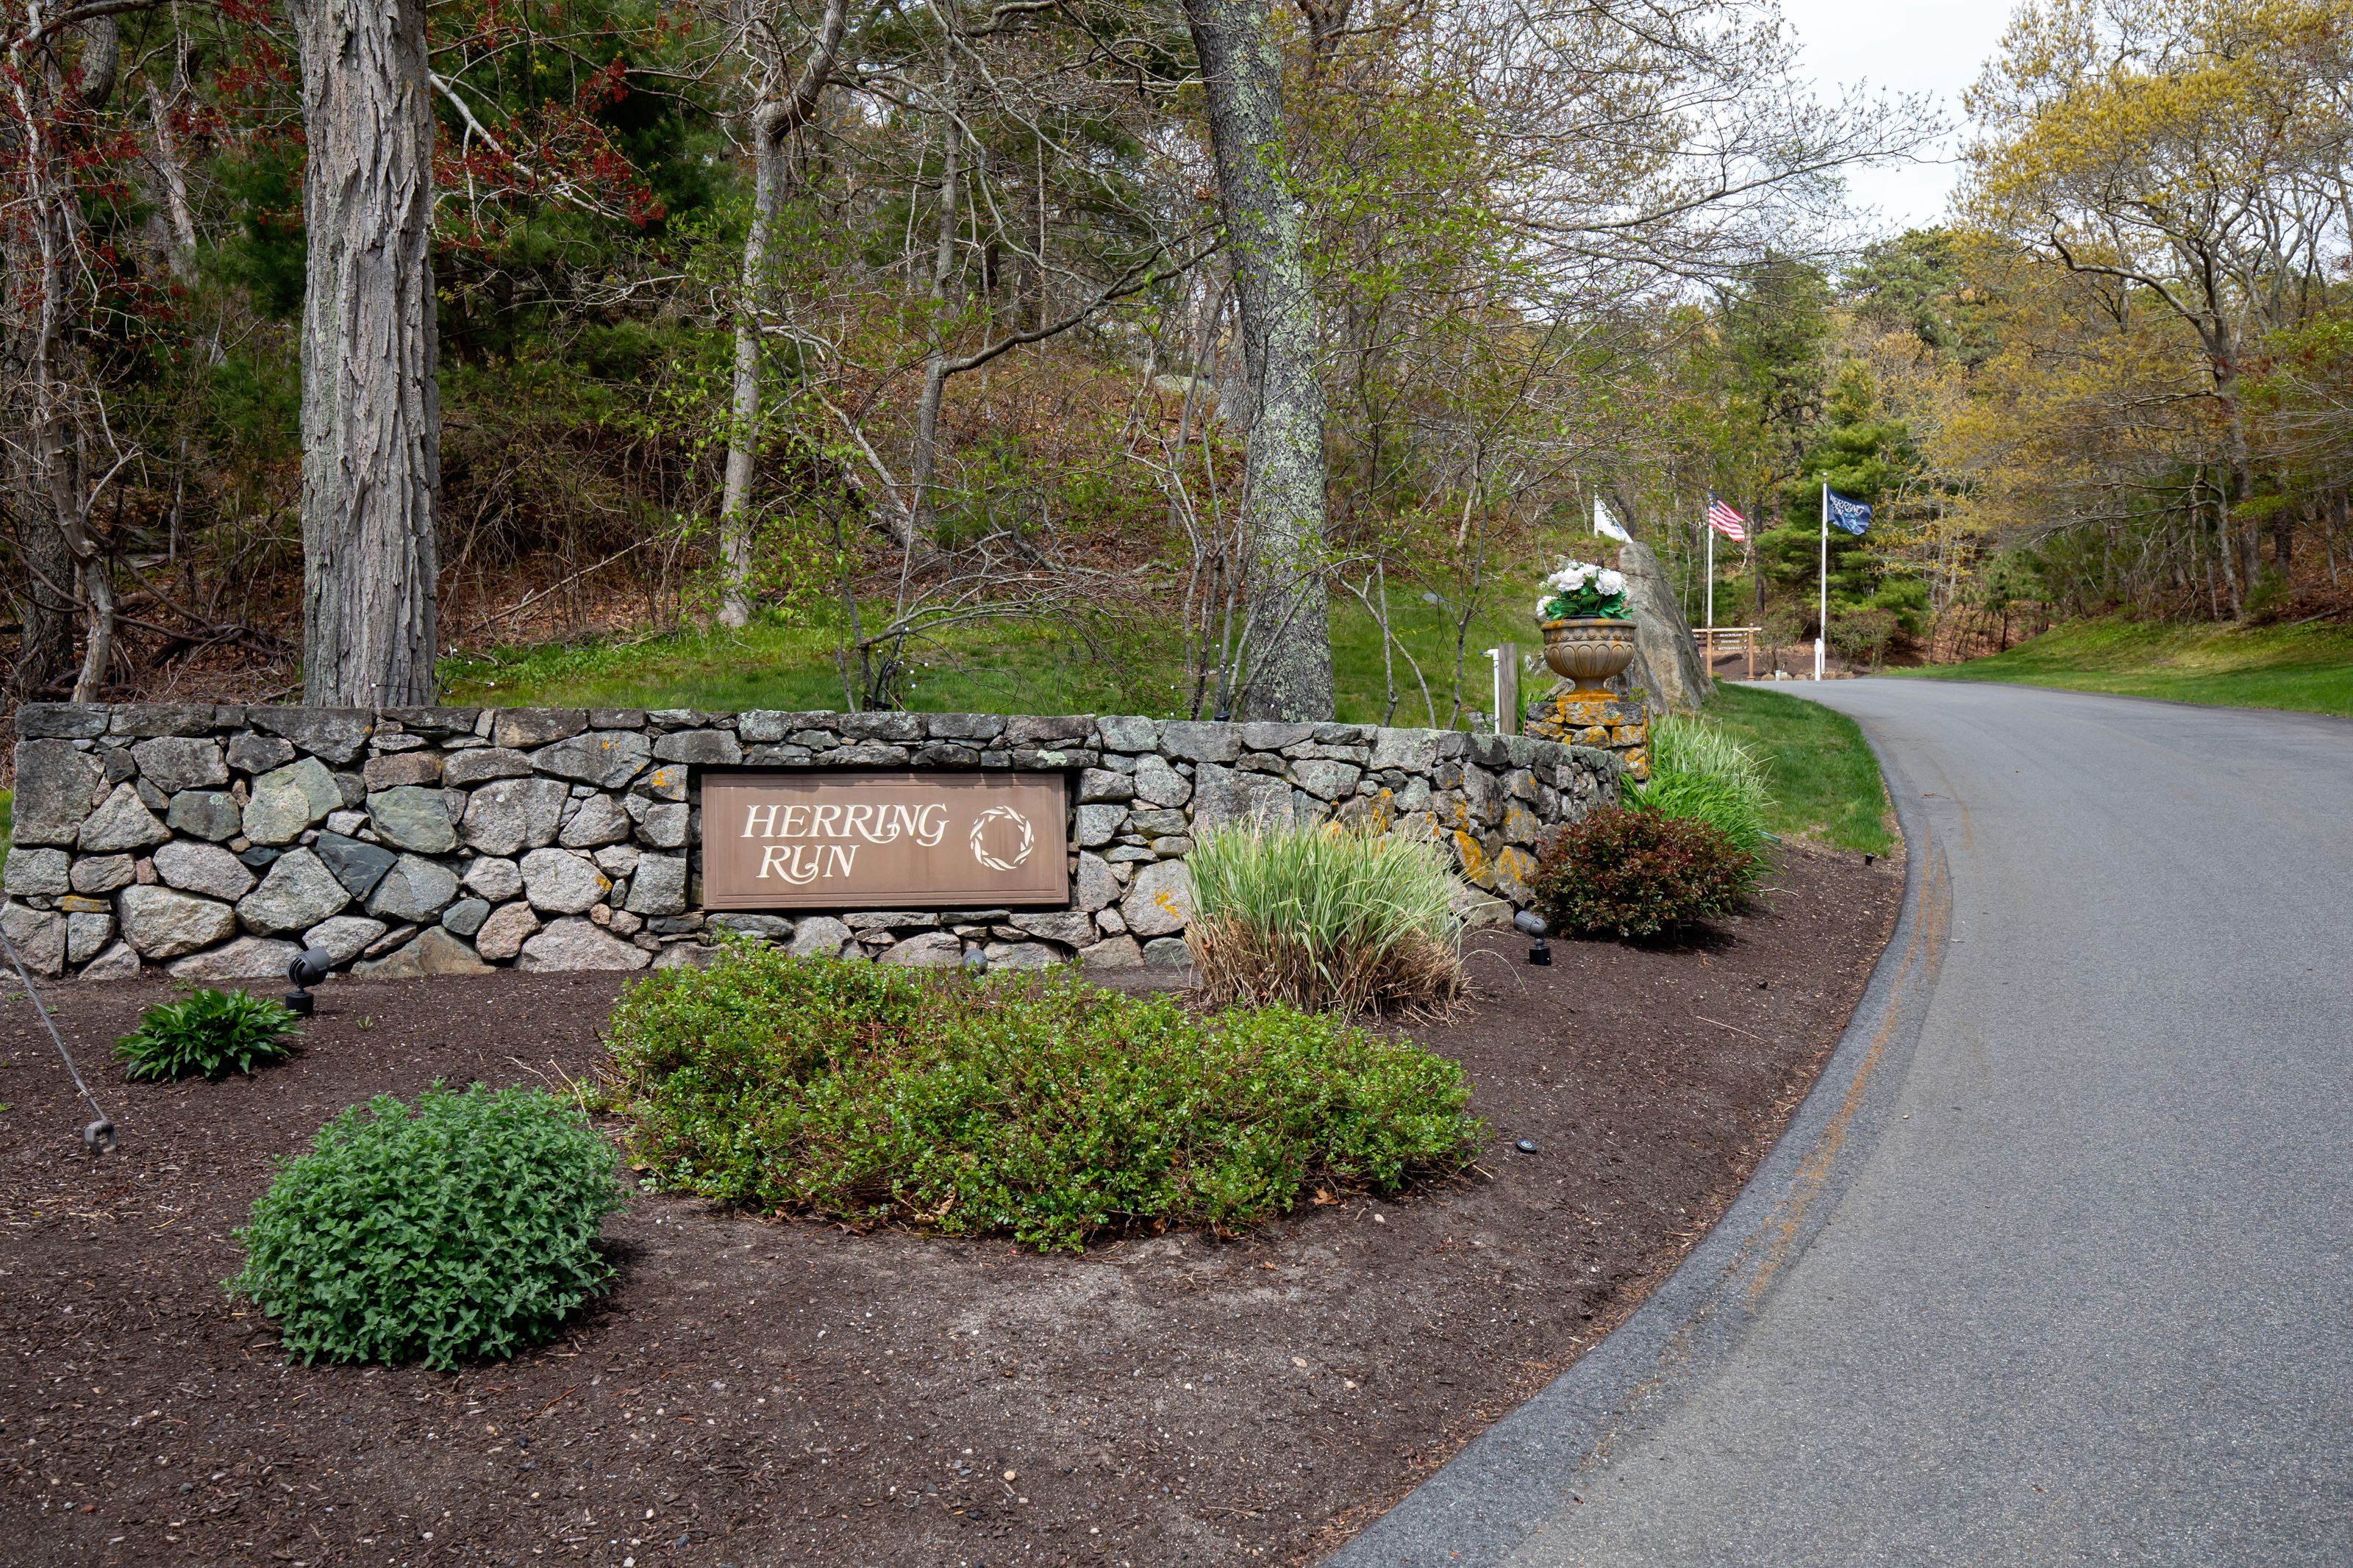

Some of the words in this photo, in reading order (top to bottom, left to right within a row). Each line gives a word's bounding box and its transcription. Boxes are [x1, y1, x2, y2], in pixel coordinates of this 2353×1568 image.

[1829, 493, 1865, 515] HERRING
[740, 803, 951, 847] HERRING
[756, 844, 861, 885] RUN
